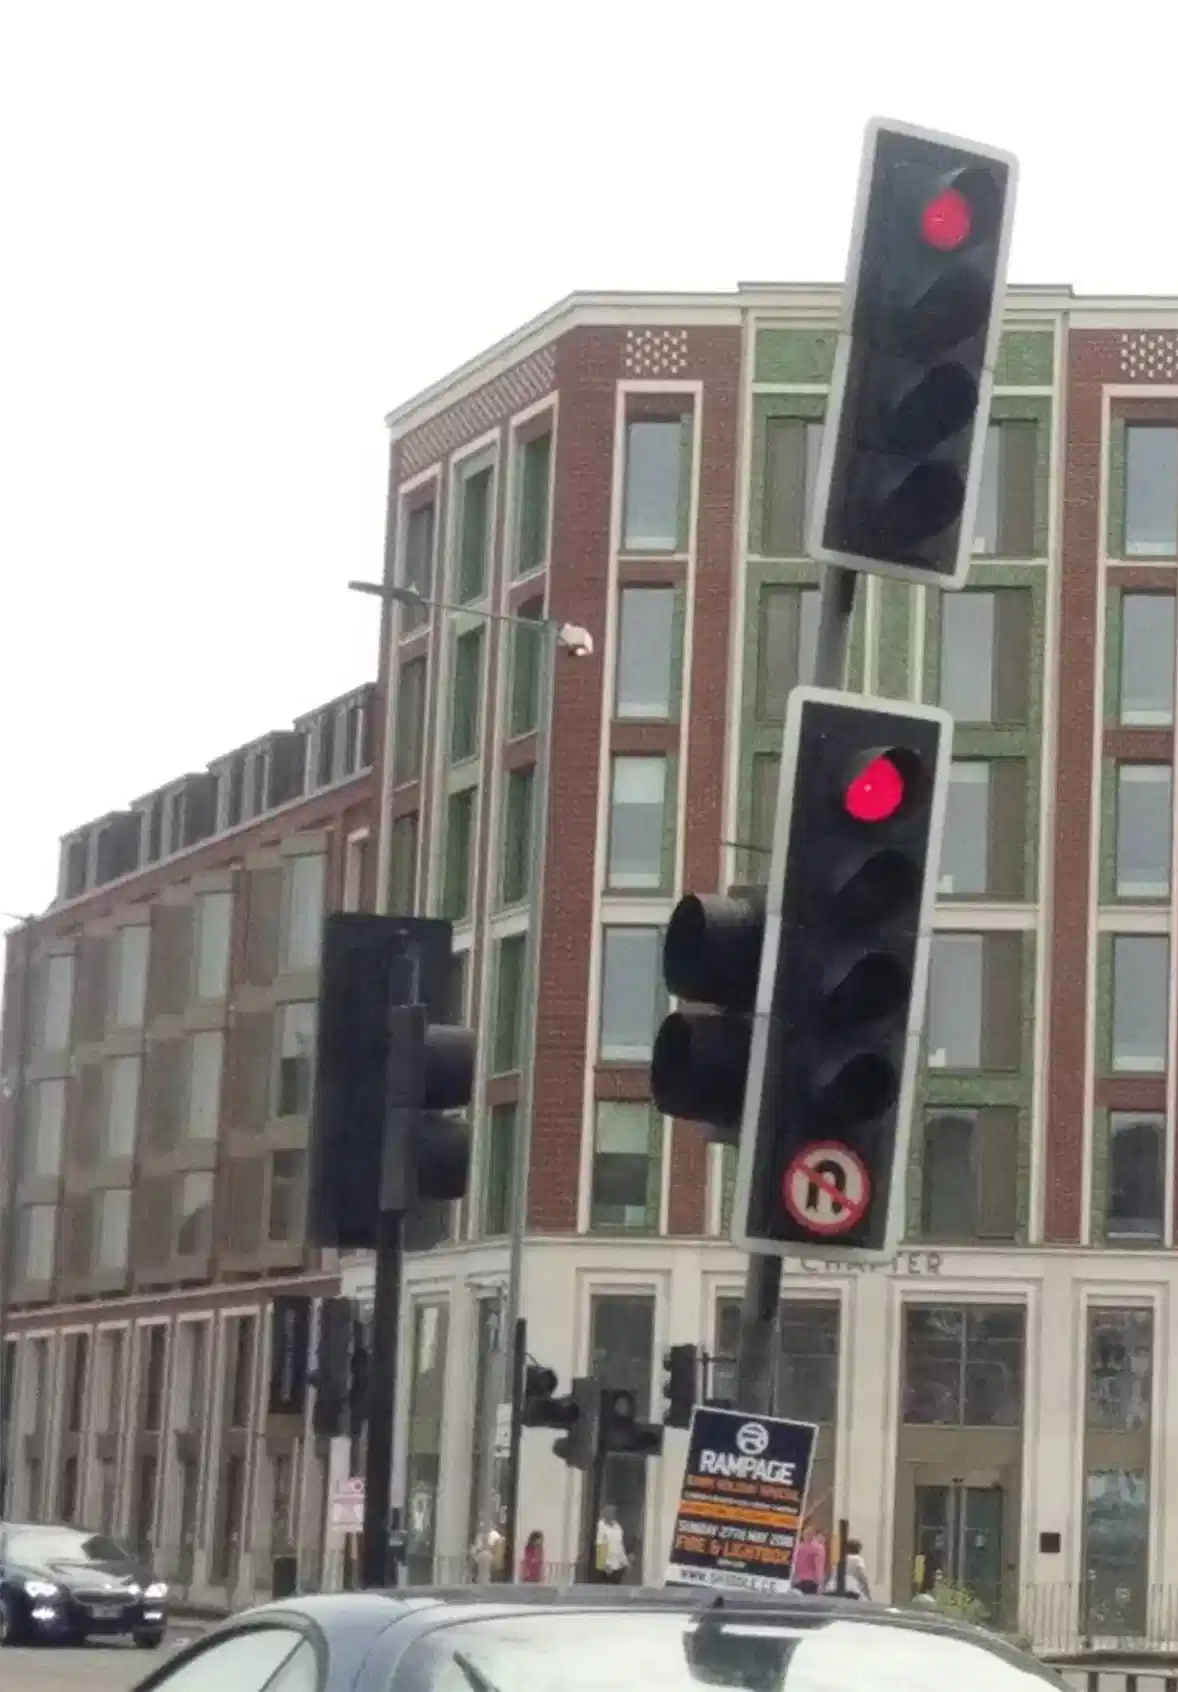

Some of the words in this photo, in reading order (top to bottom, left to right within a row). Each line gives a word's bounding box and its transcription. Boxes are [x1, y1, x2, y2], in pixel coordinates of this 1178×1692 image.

[700, 1450, 796, 1485] RAMPAGE
[679, 1520, 718, 1538] SUNDAY
[748, 1530, 769, 1544] MAY
